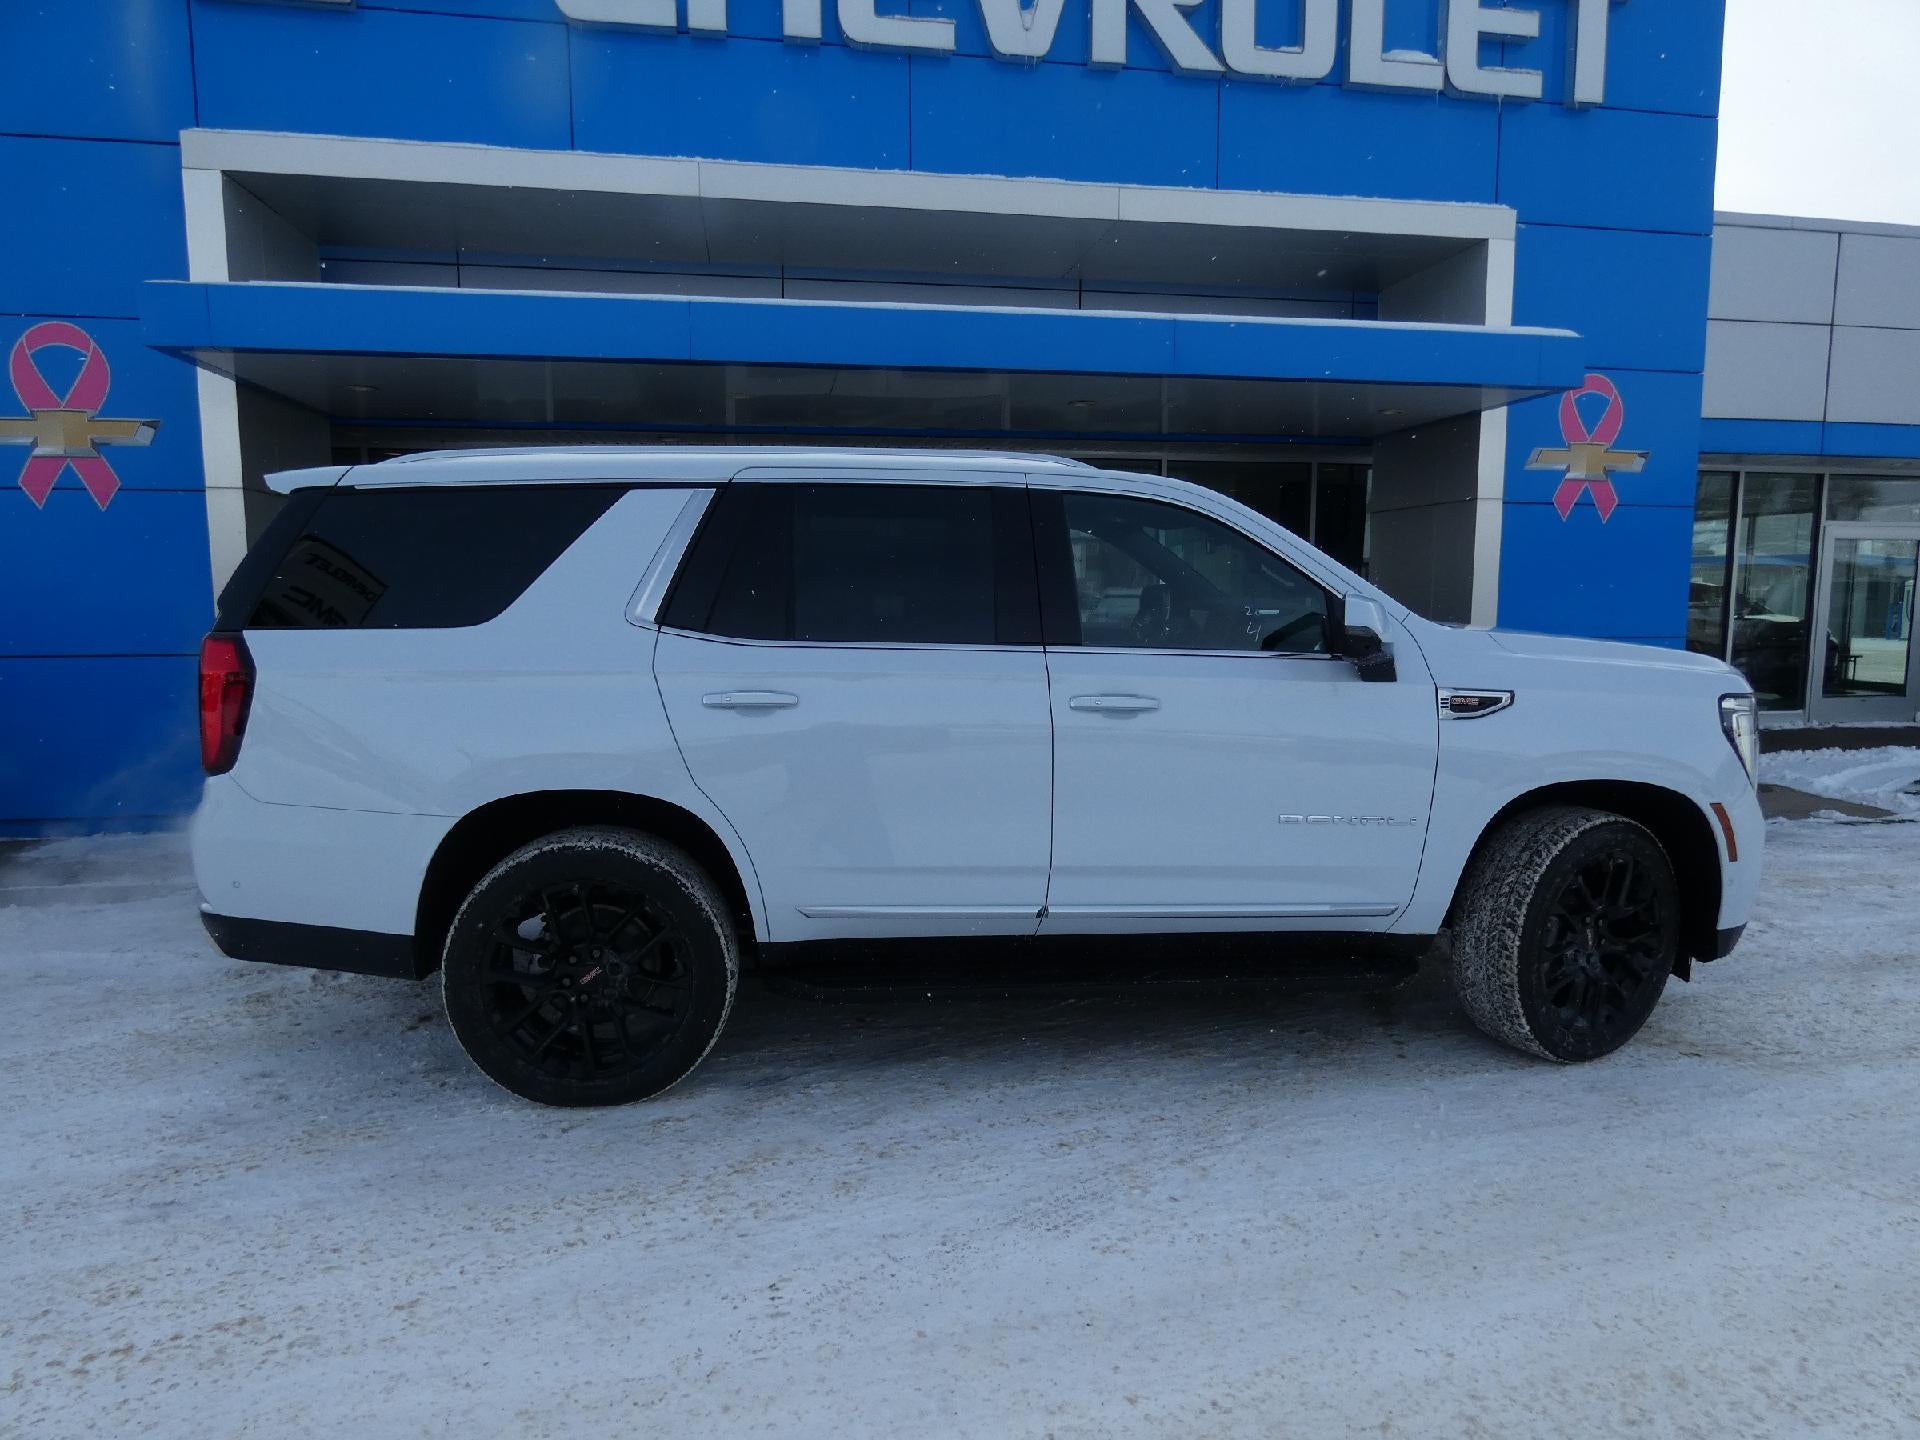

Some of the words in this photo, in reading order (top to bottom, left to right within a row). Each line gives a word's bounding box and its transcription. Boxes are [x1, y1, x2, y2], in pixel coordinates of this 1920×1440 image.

[554, 0, 1628, 108] ROLET
[1451, 697, 1480, 706] GMC
[1279, 814, 1417, 826] DENALI
